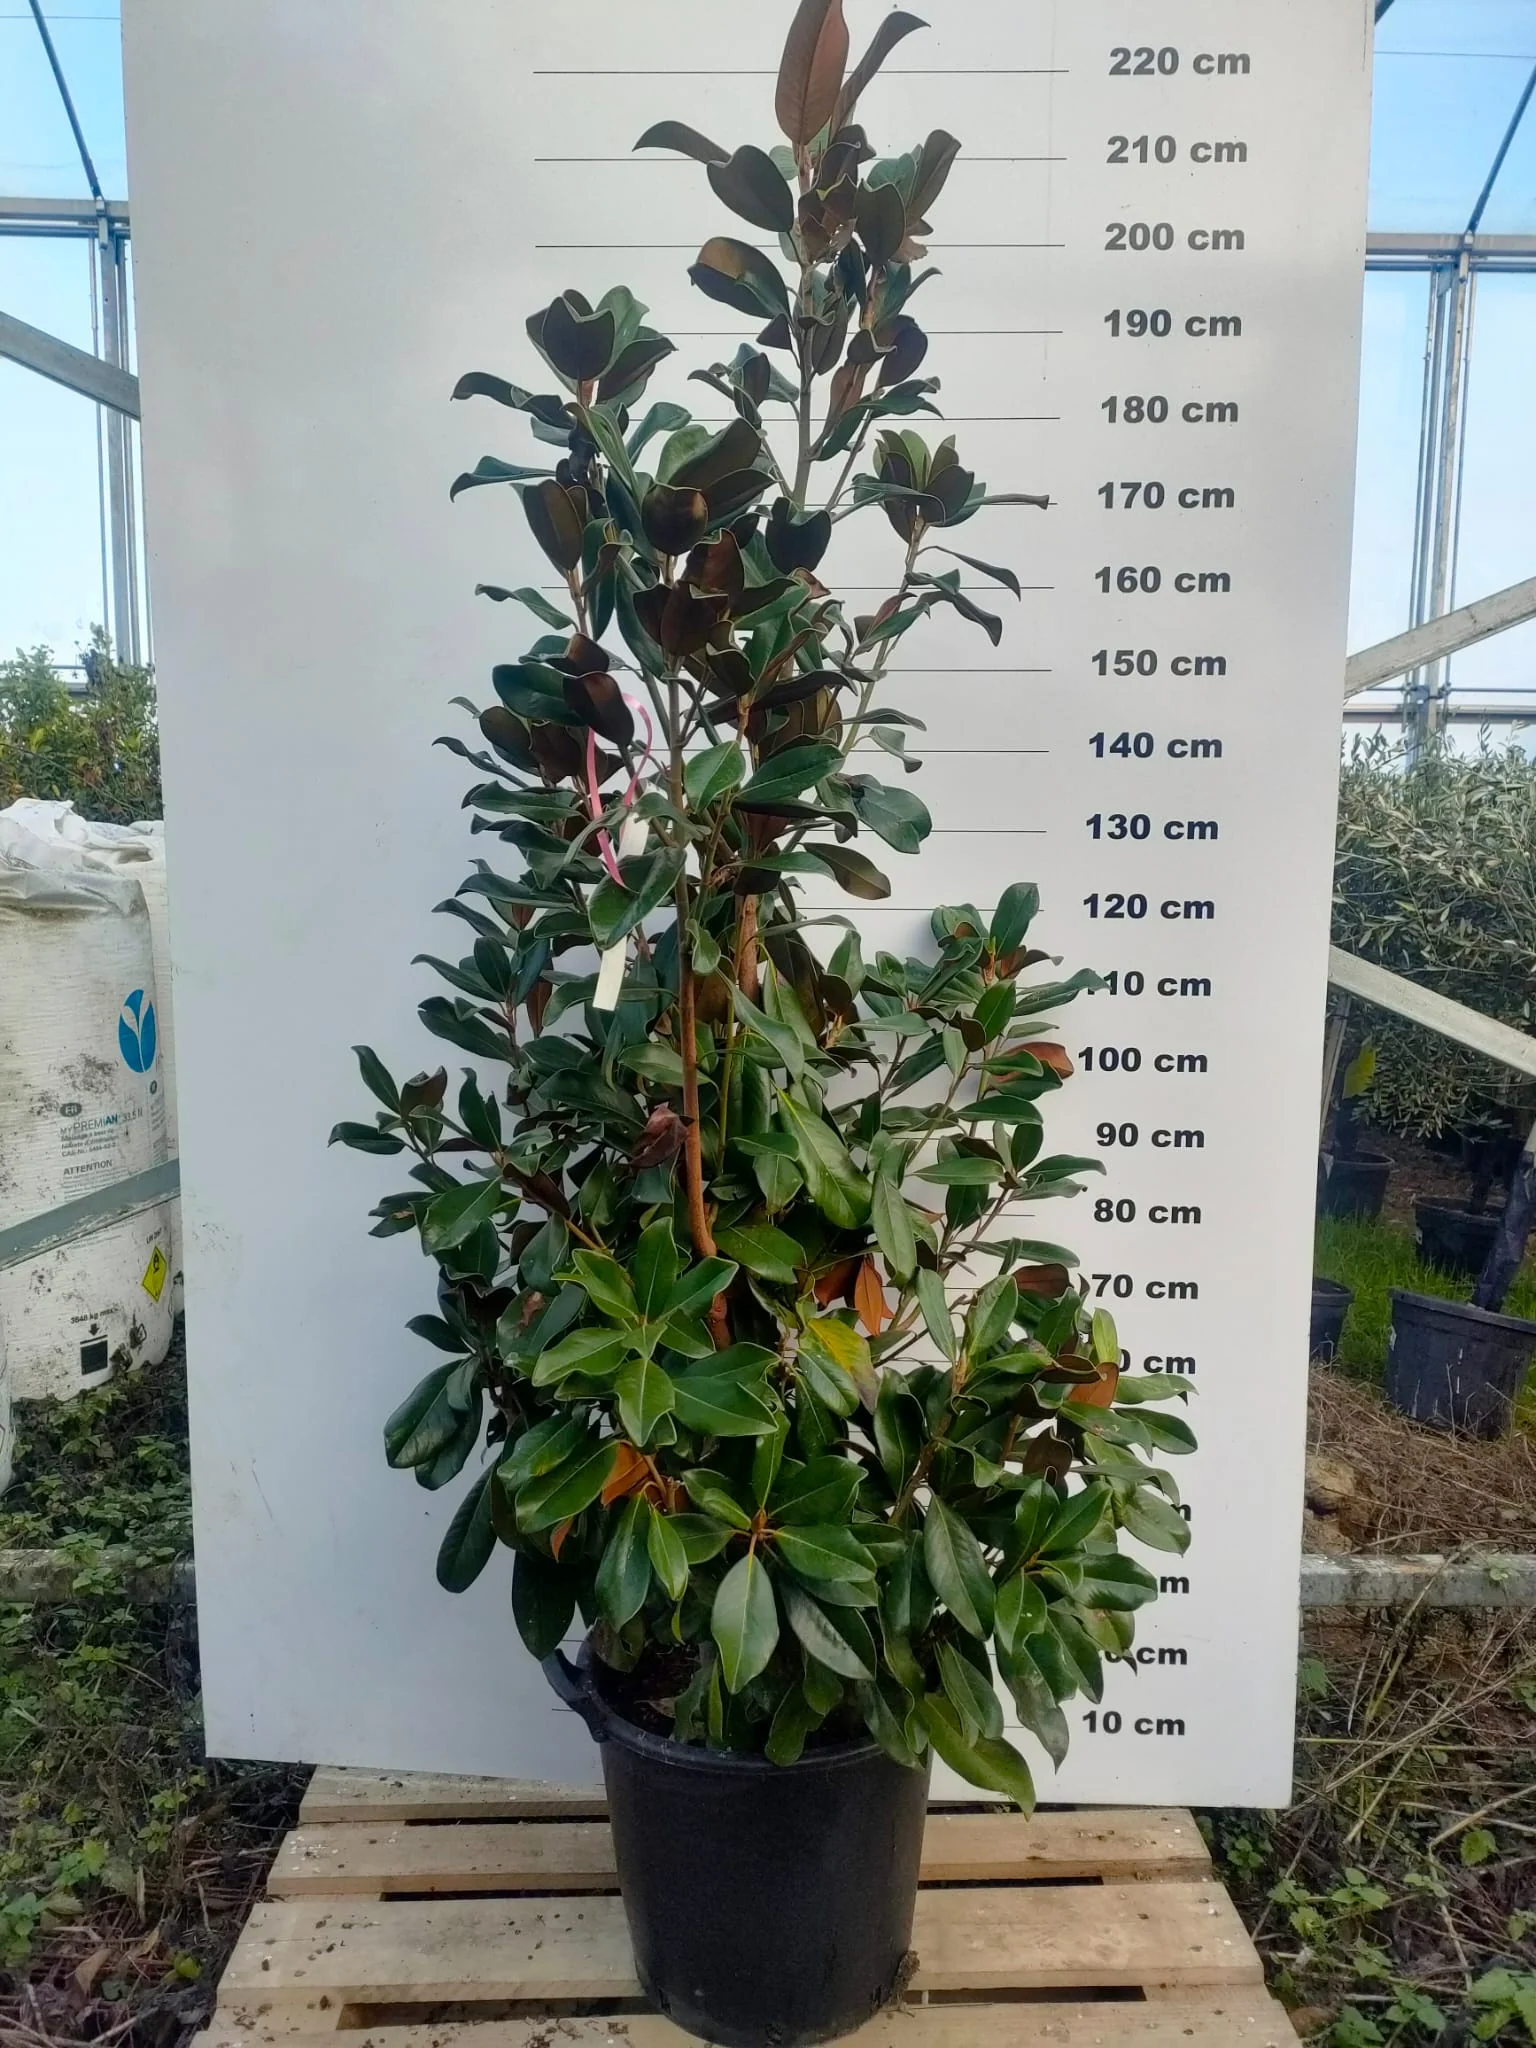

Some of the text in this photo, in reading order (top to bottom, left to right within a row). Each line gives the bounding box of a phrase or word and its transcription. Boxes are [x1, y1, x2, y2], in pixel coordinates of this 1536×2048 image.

[1109, 47, 1250, 75] 220 cm
[1106, 135, 1247, 163] 210 cm
[1105, 223, 1245, 251] 200 cm
[1104, 309, 1242, 337] 190 cm
[1101, 395, 1238, 423] 180 cm
[1098, 481, 1235, 509] 170 cm
[1095, 566, 1231, 593] 160 cm
[1091, 649, 1227, 677] 150 cm
[1088, 731, 1223, 759] 140 cm
[1086, 813, 1219, 840] 130 cm
[1083, 893, 1215, 920] 120 cm
[1087, 970, 1212, 997] 10 cm
[1078, 1046, 1208, 1073] 100 cm
[1096, 1122, 1205, 1148] 90 cm
[63, 1160, 113, 1175] ATTENTION
[1093, 1198, 1202, 1225] 80 cm
[1091, 1273, 1199, 1300] 70 cm
[1143, 1355, 1196, 1374] cm
[1136, 1647, 1188, 1666] cm
[1082, 1710, 1185, 1736] 10 cm
